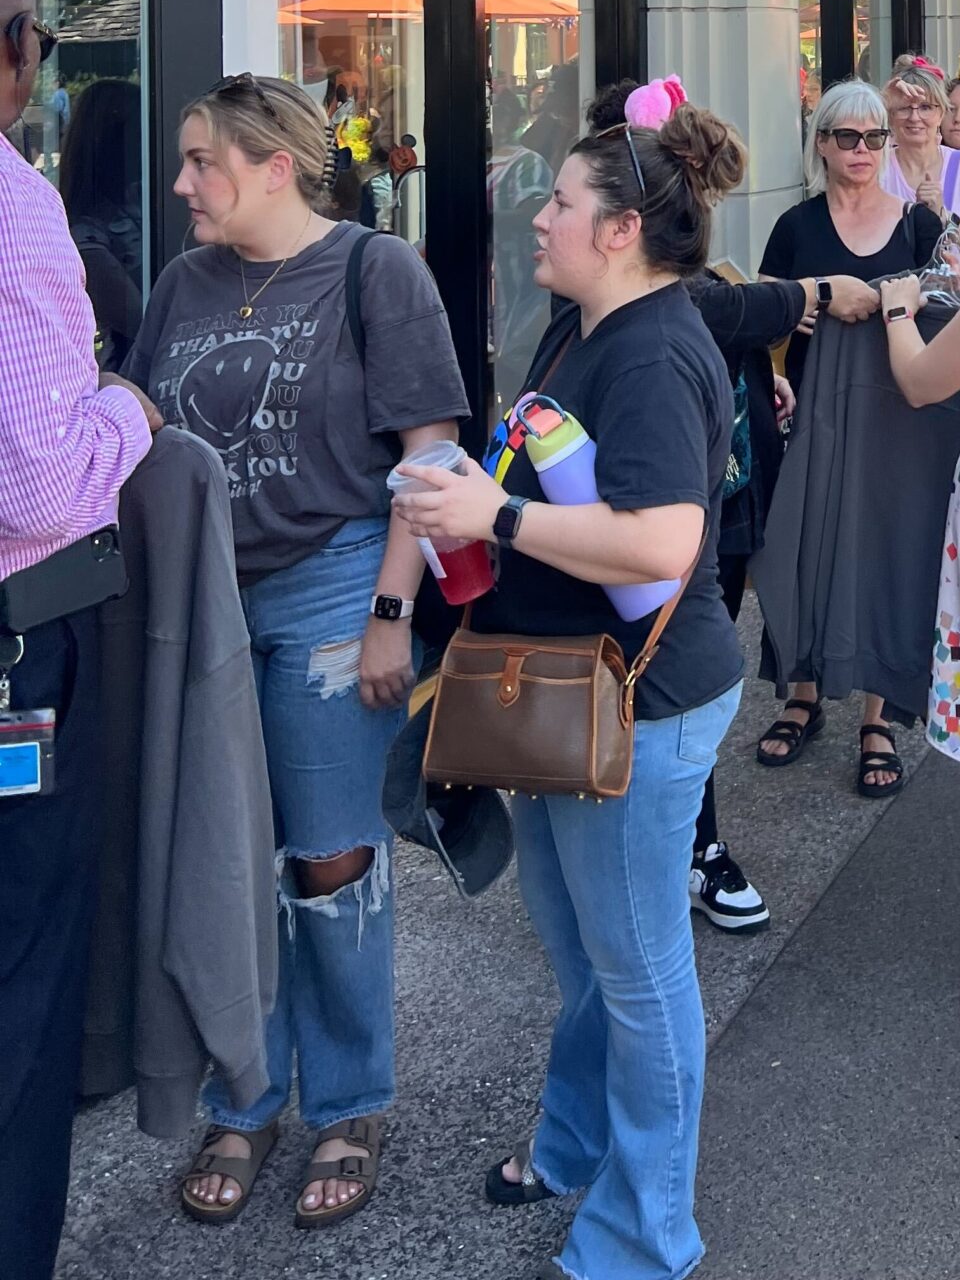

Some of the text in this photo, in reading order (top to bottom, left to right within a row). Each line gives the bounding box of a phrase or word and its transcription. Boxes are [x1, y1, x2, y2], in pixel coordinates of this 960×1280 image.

[176, 307, 267, 338] THANK
[271, 320, 320, 342] YOU
[270, 361, 307, 382] OU
